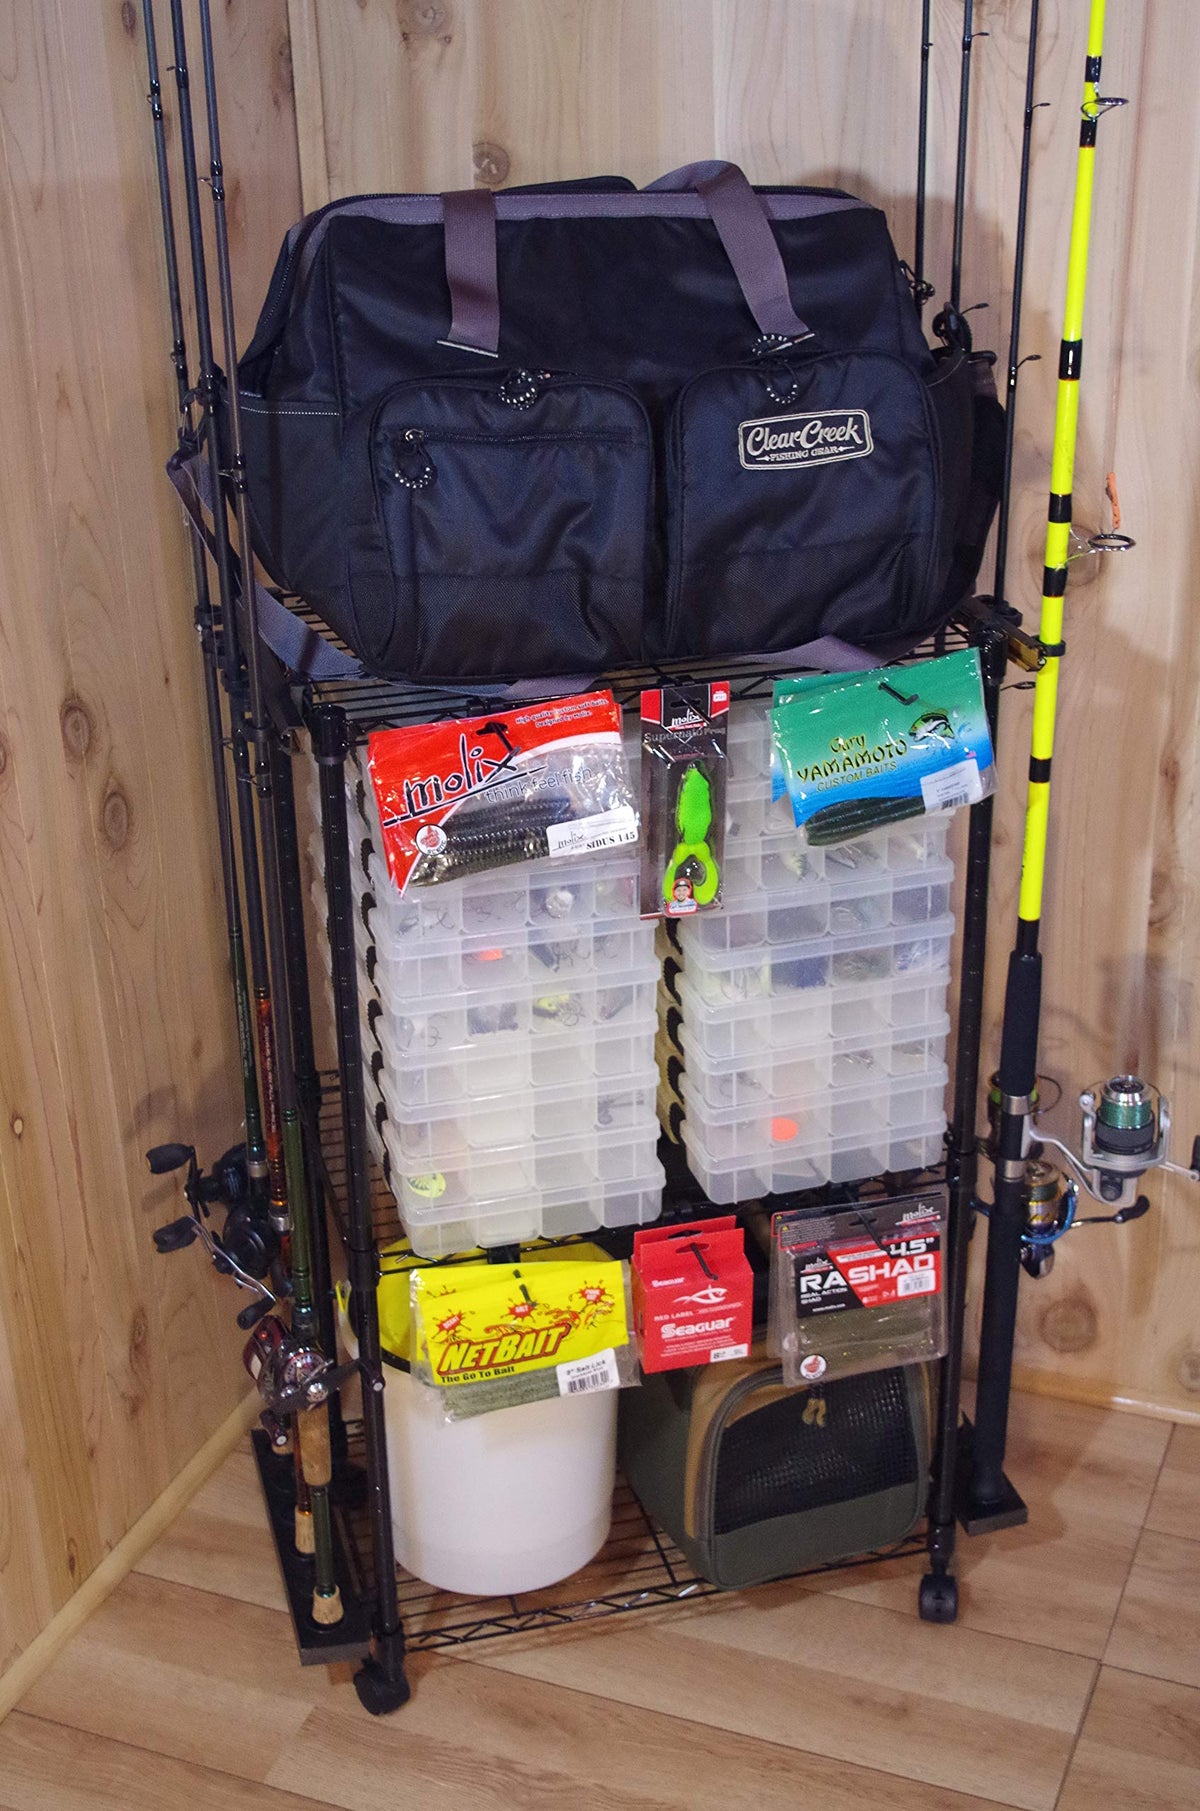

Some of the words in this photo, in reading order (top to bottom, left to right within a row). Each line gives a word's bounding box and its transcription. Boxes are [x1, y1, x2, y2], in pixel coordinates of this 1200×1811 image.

[770, 450, 810, 462] FISHING
[811, 446, 839, 457] GEAR
[515, 716, 531, 725] High
[532, 711, 553, 721] quality
[535, 716, 564, 728] Designed
[671, 708, 702, 727] molix
[831, 733, 865, 755] Gary
[797, 738, 908, 784] YAMAMOTO
[403, 732, 521, 817] molix
[816, 768, 863, 793] CUSTOM
[866, 760, 898, 779] BAITS
[485, 782, 527, 803] think
[531, 772, 561, 792] feel
[561, 767, 593, 784] fish
[557, 831, 584, 850] molix
[586, 837, 615, 850] SIDUS
[618, 831, 636, 842] 145
[903, 1202, 935, 1222] molix
[890, 1237, 935, 1257] 4.5"
[848, 1254, 935, 1285] SHAD
[651, 1277, 686, 1288] Seaguar
[822, 1287, 848, 1296] ACTION
[801, 1296, 822, 1304] SHAD
[653, 1313, 670, 1322] RED
[671, 1310, 694, 1319] LABEL
[660, 1317, 735, 1340] Seaguar
[440, 1374, 460, 1384] The
[462, 1371, 477, 1381] Go
[479, 1369, 491, 1379] To
[493, 1364, 515, 1376] Bait
